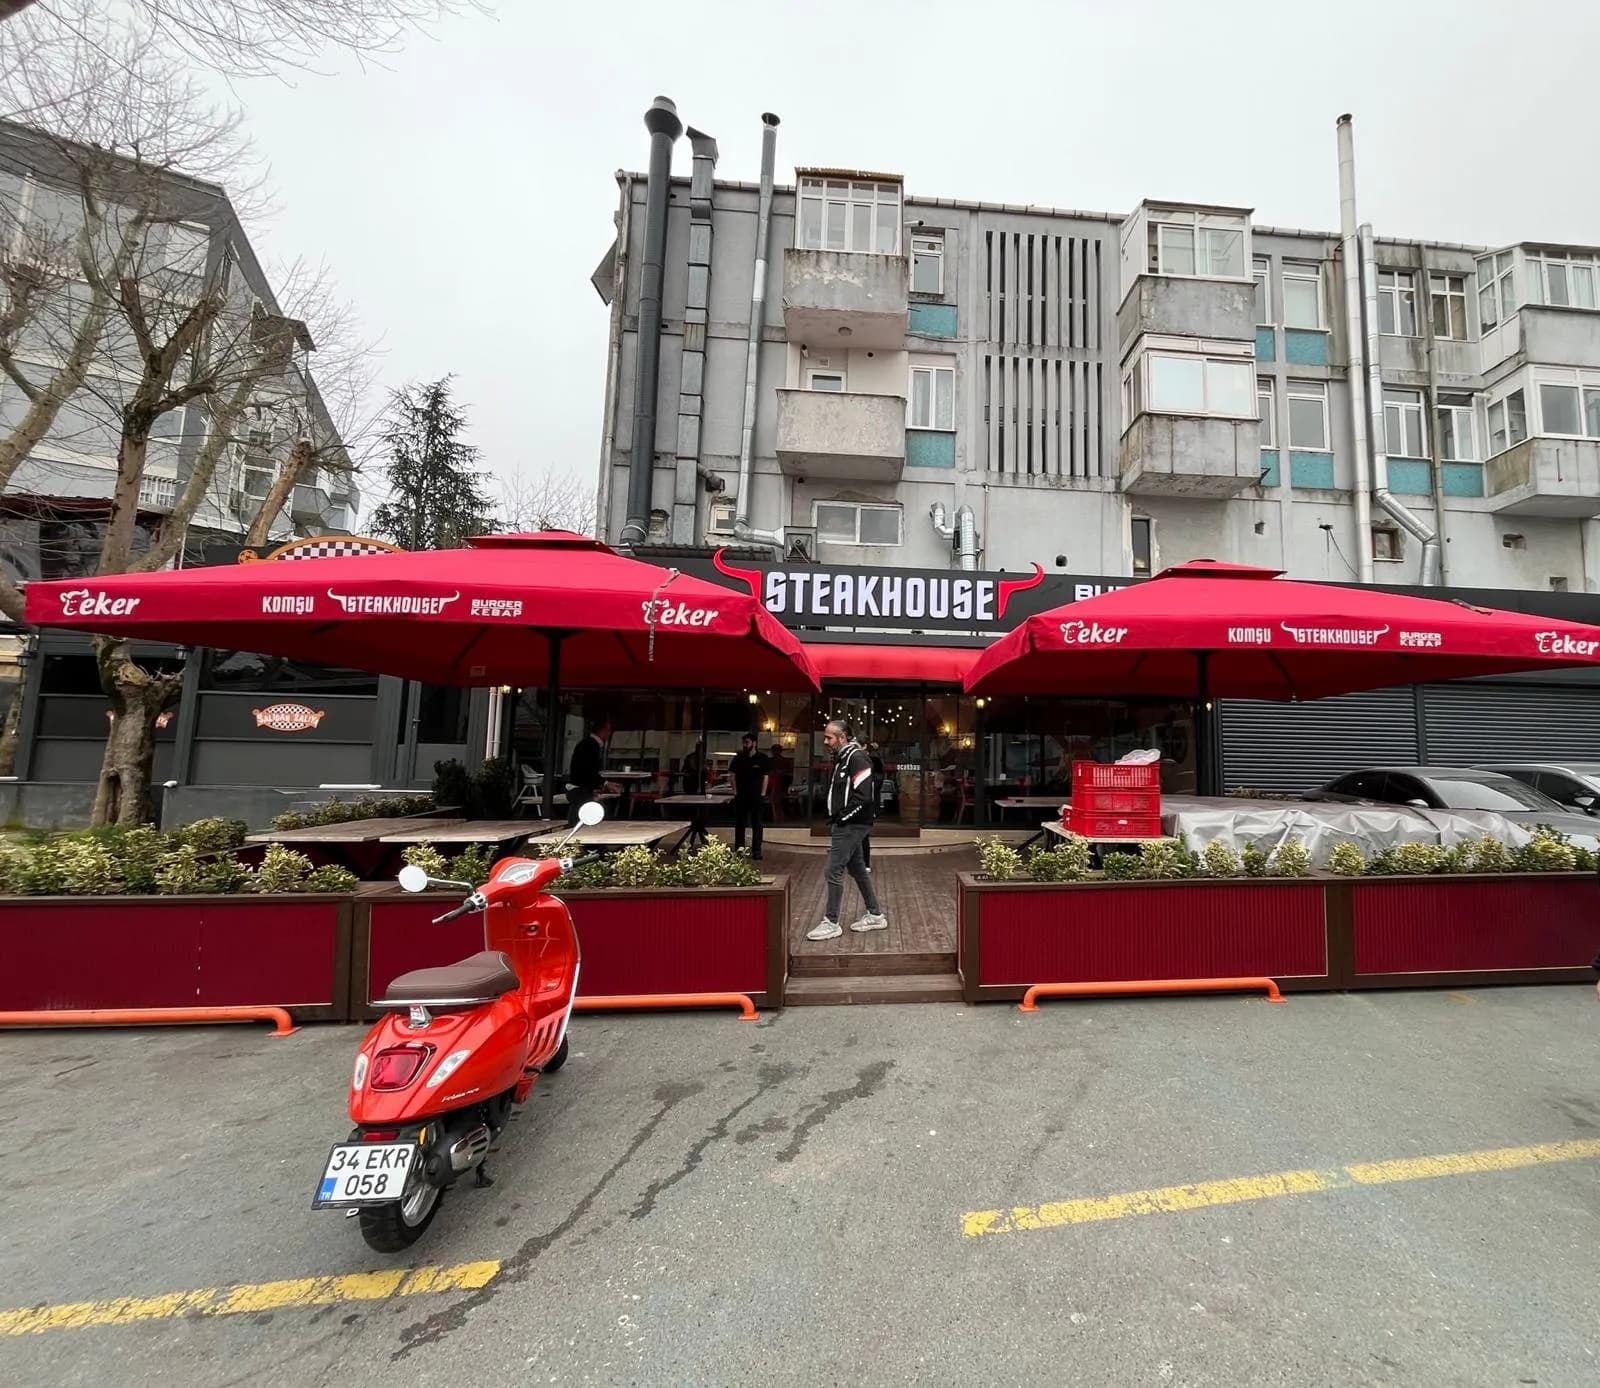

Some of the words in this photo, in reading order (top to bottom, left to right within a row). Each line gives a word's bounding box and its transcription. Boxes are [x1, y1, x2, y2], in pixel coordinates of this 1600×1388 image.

[471, 599, 523, 609] BURGER
[765, 571, 994, 621] STEAKHOUSE
[262, 596, 314, 615] KOMŞU
[347, 596, 439, 615] STEAKHOUSE
[471, 608, 522, 617] KEBAP
[1298, 628, 1373, 645] STEAKHOUSE
[1400, 631, 1442, 640] BURGER
[1400, 639, 1442, 647] KEBAP
[332, 1150, 360, 1171] 34
[365, 1148, 410, 1169] EKR
[344, 1173, 389, 1196] 058
